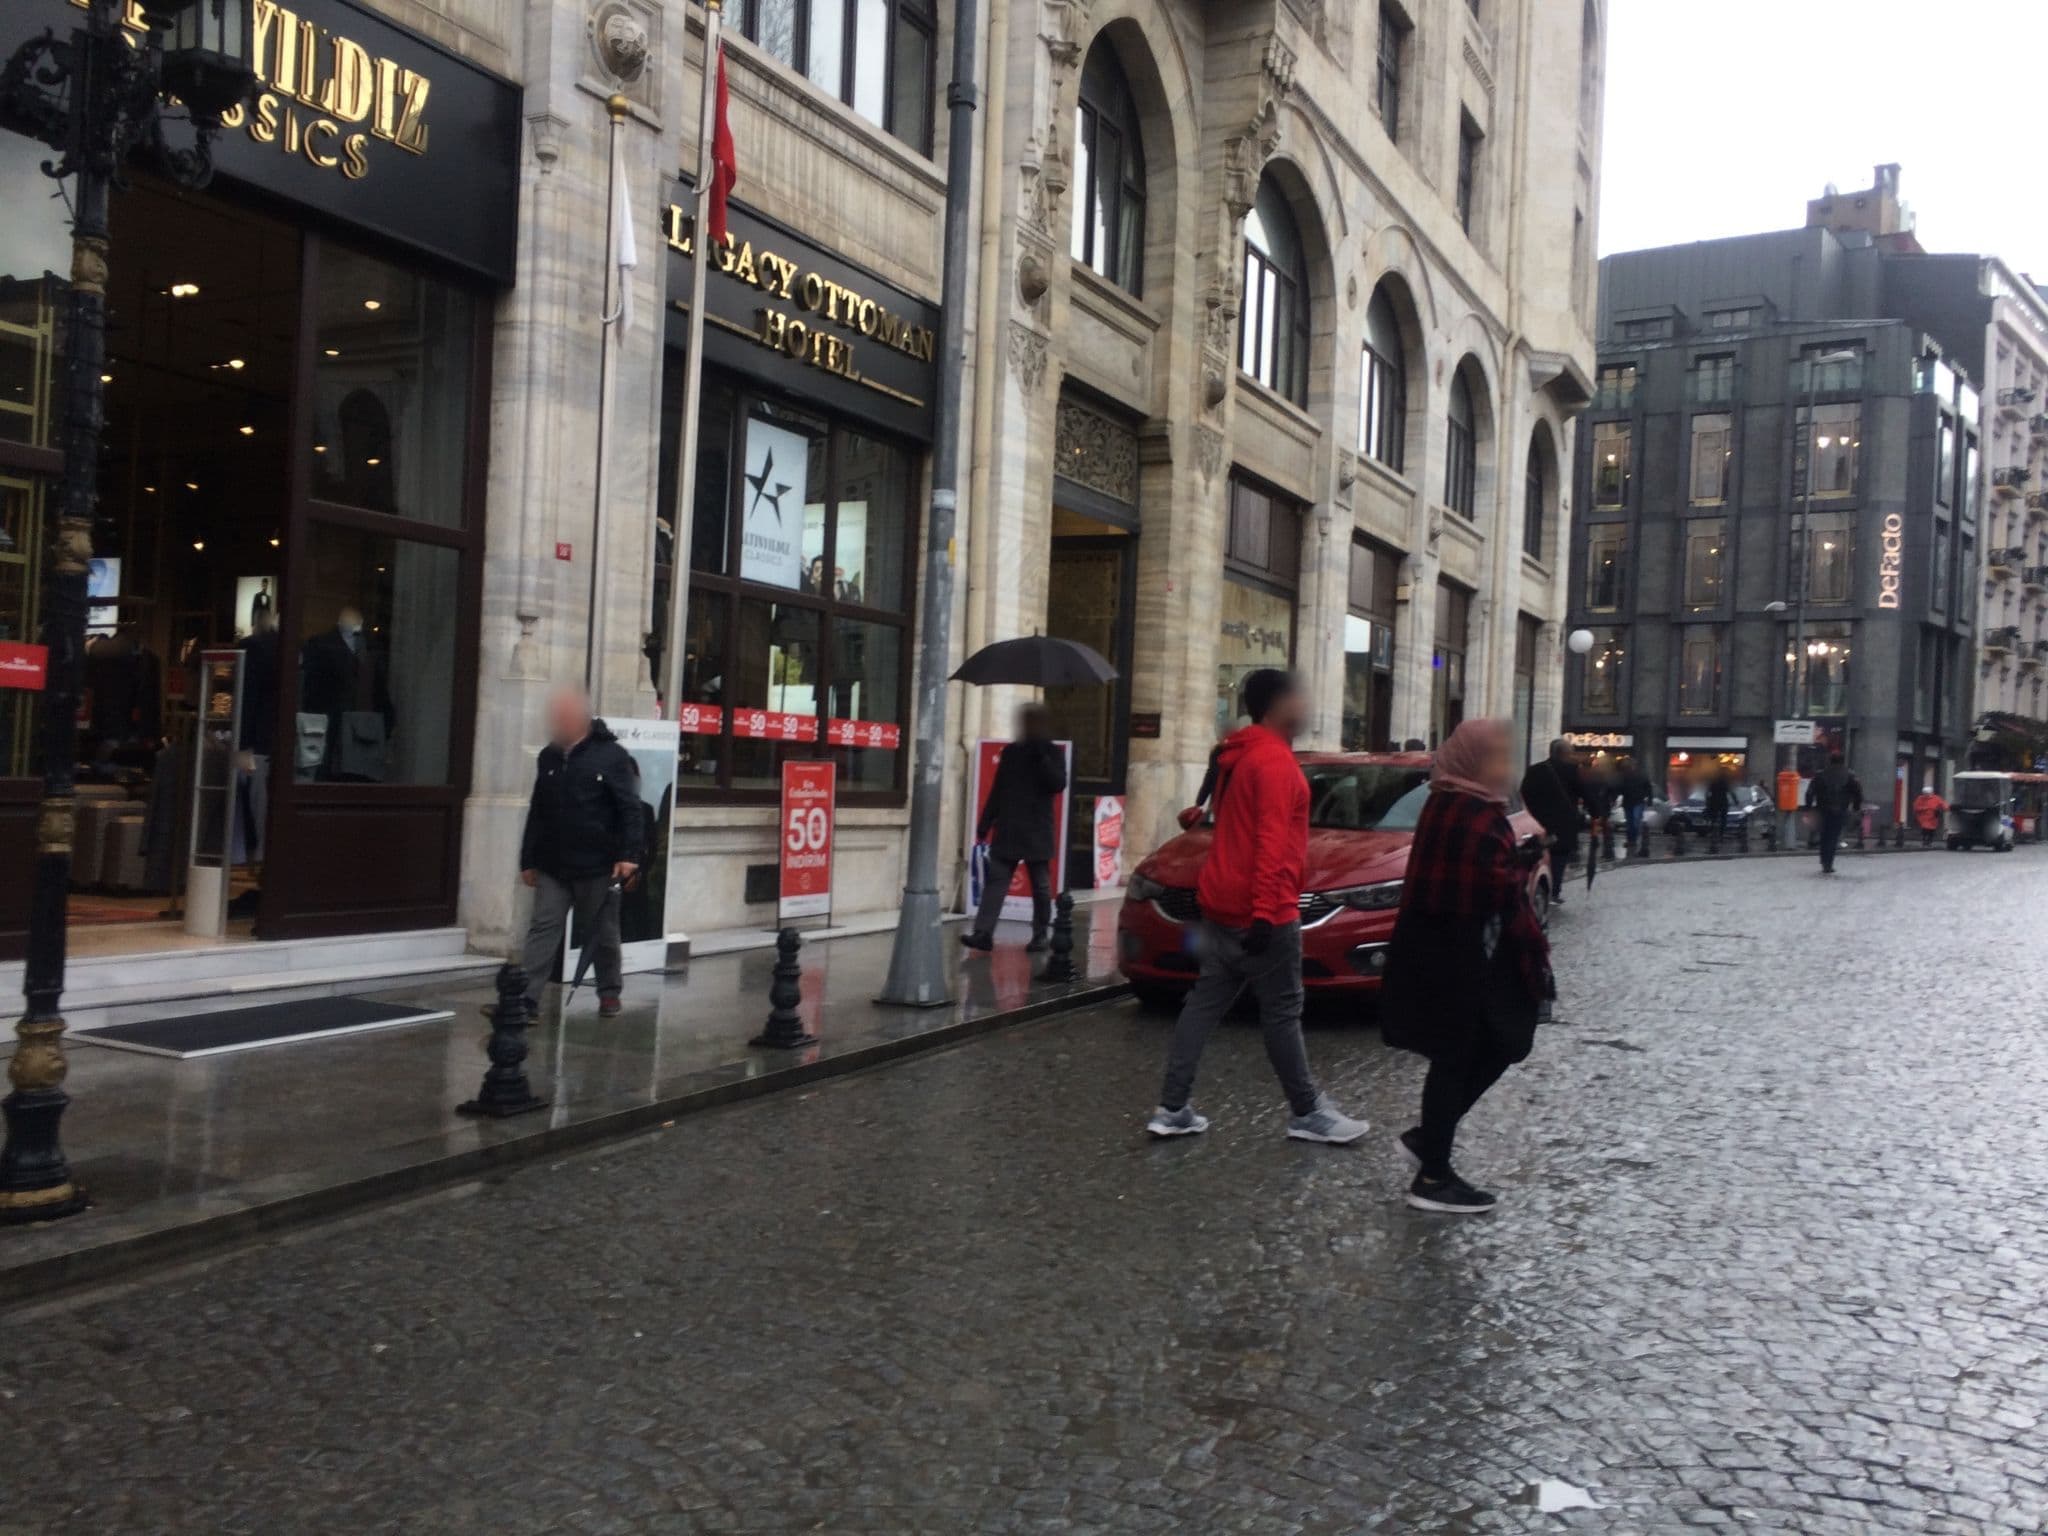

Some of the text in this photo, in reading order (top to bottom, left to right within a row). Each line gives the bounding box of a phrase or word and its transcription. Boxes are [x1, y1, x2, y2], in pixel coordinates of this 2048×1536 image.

[668, 203, 934, 362] LGACY OTTOMAN
[762, 309, 861, 381] HOTEL
[1878, 513, 1902, 608] DeFacto
[1563, 732, 1625, 747] DeFacto
[787, 807, 827, 851] 50
